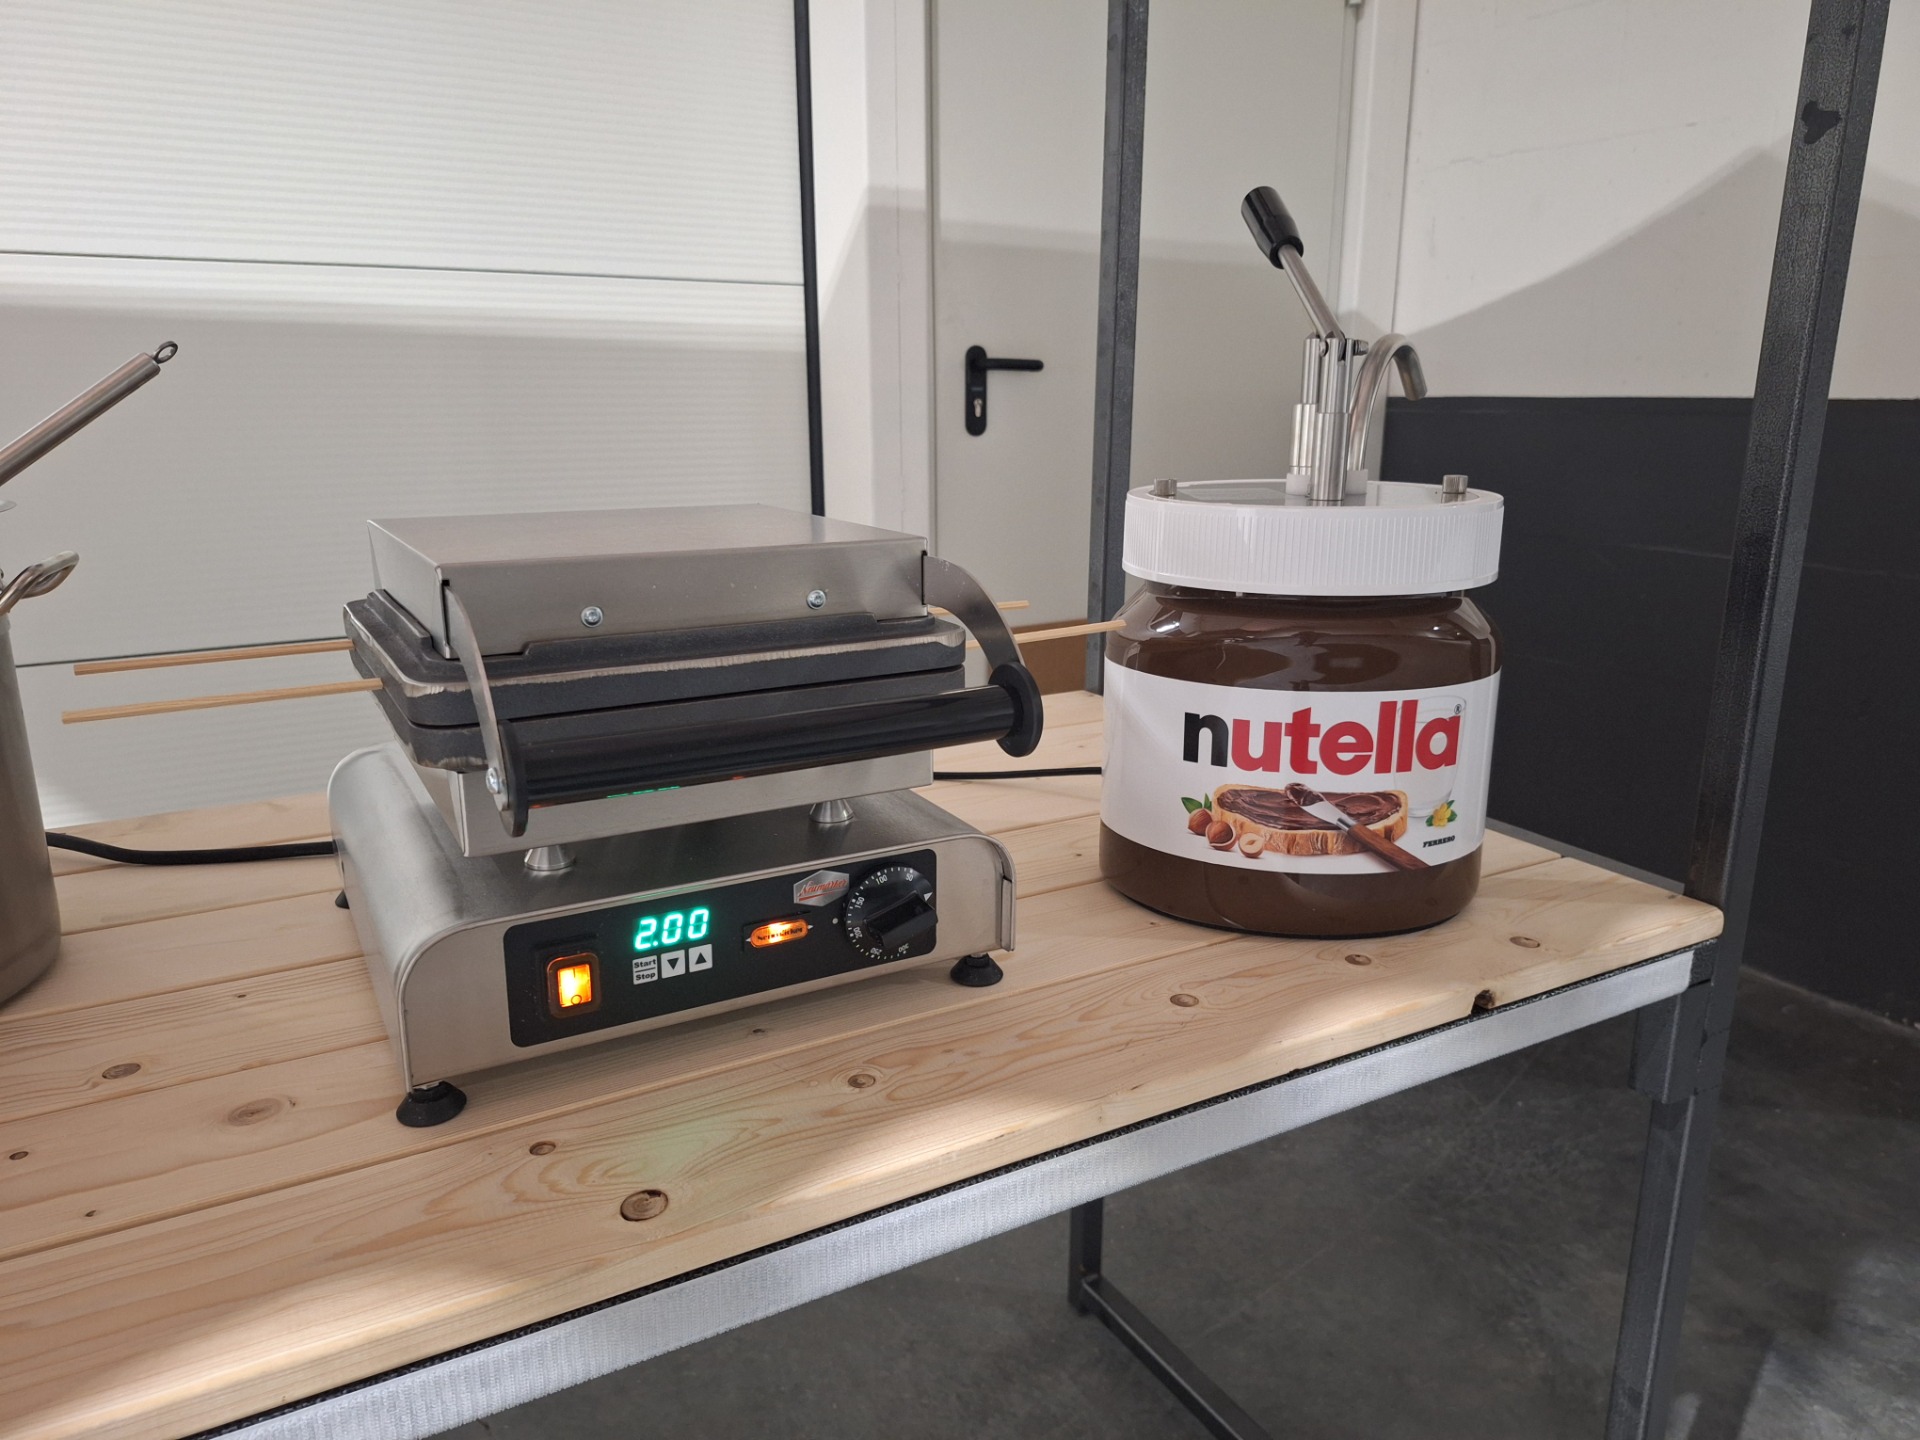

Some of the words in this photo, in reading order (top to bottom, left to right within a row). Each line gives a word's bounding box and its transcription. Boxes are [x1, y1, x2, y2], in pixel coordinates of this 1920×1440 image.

[1183, 699, 1461, 776] nutella
[875, 874, 888, 885] 100
[905, 873, 914, 882] 50
[854, 896, 865, 909] 150
[634, 907, 710, 950] 2.00
[634, 957, 657, 969] Start
[635, 971, 656, 981] Stop
